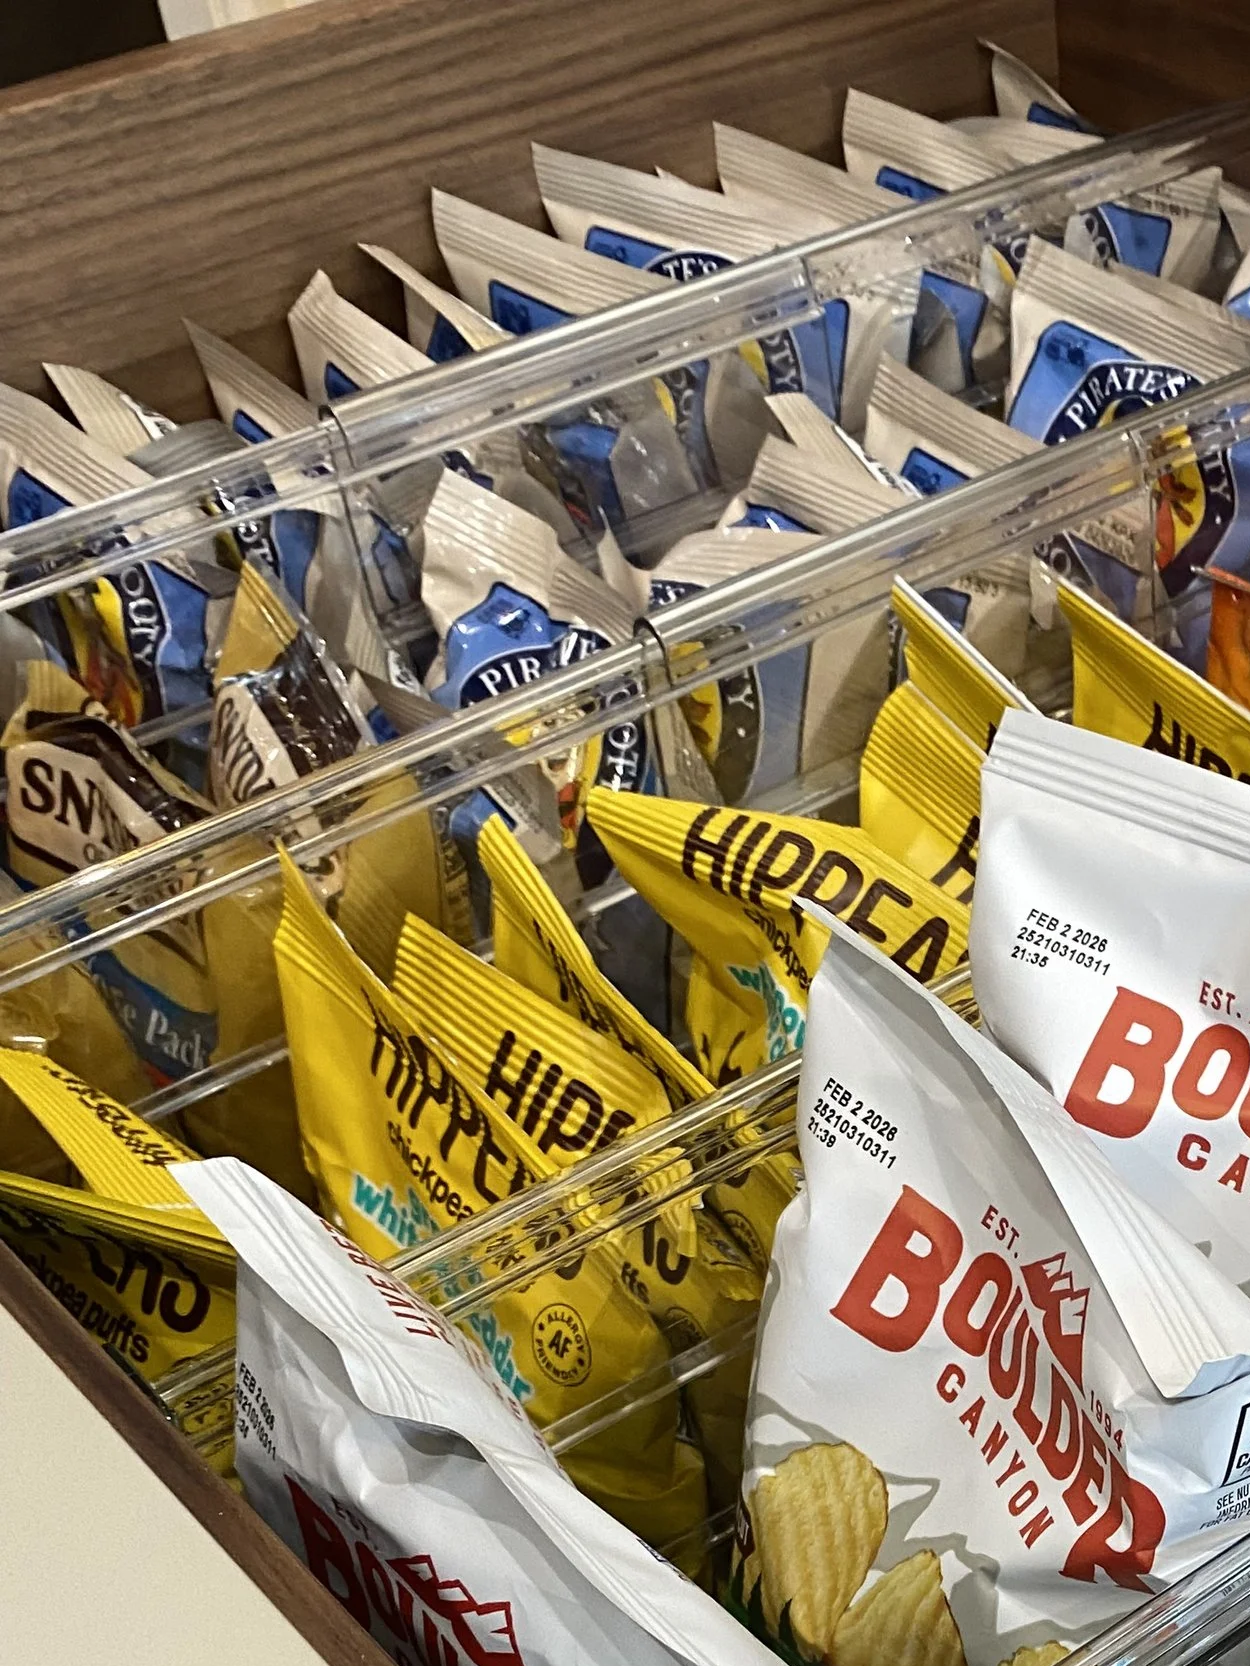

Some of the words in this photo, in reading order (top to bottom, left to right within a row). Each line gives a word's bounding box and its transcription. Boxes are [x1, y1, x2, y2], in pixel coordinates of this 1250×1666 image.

[1017, 926, 1111, 976] 25210310311
[1027, 908, 1059, 933] FEB
[1060, 924, 1071, 938] 2
[1072, 928, 1108, 953] 2026
[1011, 945, 1049, 968] 21:35
[1199, 980, 1242, 1019] EST.
[807, 1115, 838, 1150] 21:39
[823, 1077, 852, 1108] FEB
[853, 1100, 863, 1115] 2
[864, 1107, 899, 1142] 2026
[812, 1097, 898, 1170] 25210310311
[549, 1330, 573, 1359] AF
[980, 1202, 1021, 1259] EST.
[1088, 1389, 1124, 1452] 1994
[829, 1183, 1166, 1595] BOULDER
[935, 1361, 1055, 1551] CANYON
[1216, 1491, 1234, 1510] SEE
